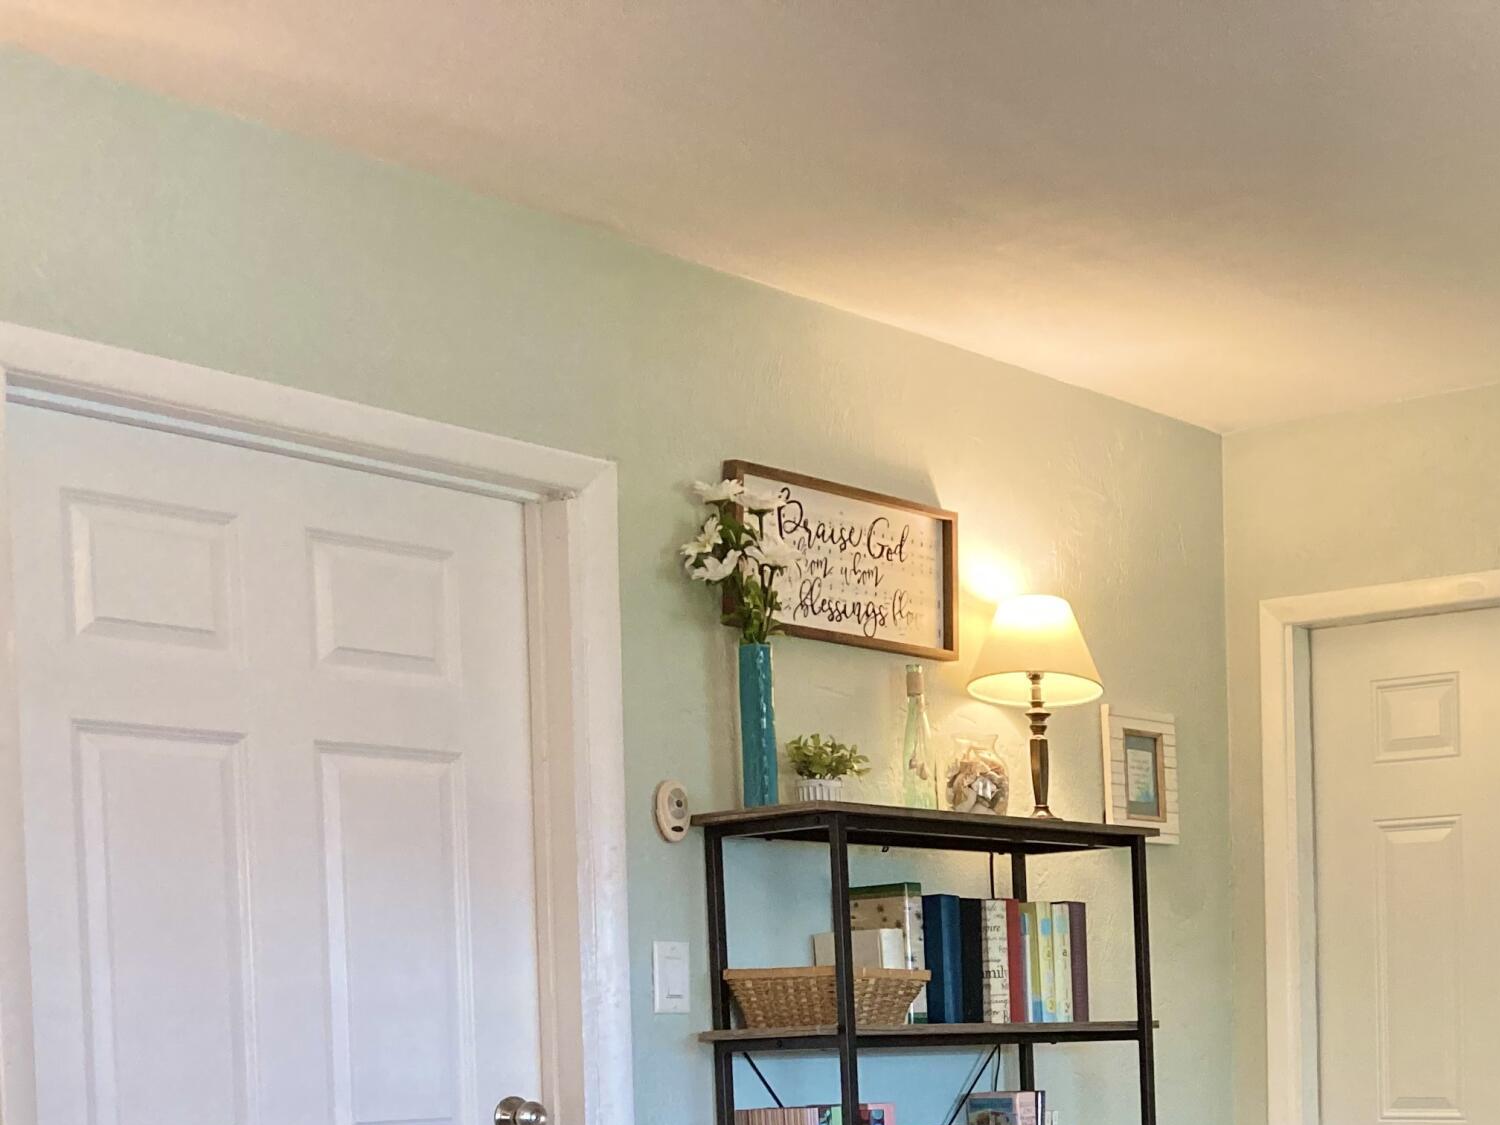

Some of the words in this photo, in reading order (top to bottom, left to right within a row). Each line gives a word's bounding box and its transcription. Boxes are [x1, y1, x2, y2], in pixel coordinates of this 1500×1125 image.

[777, 487, 863, 552] Praise
[867, 516, 910, 564] God
[793, 576, 888, 639] blessings
